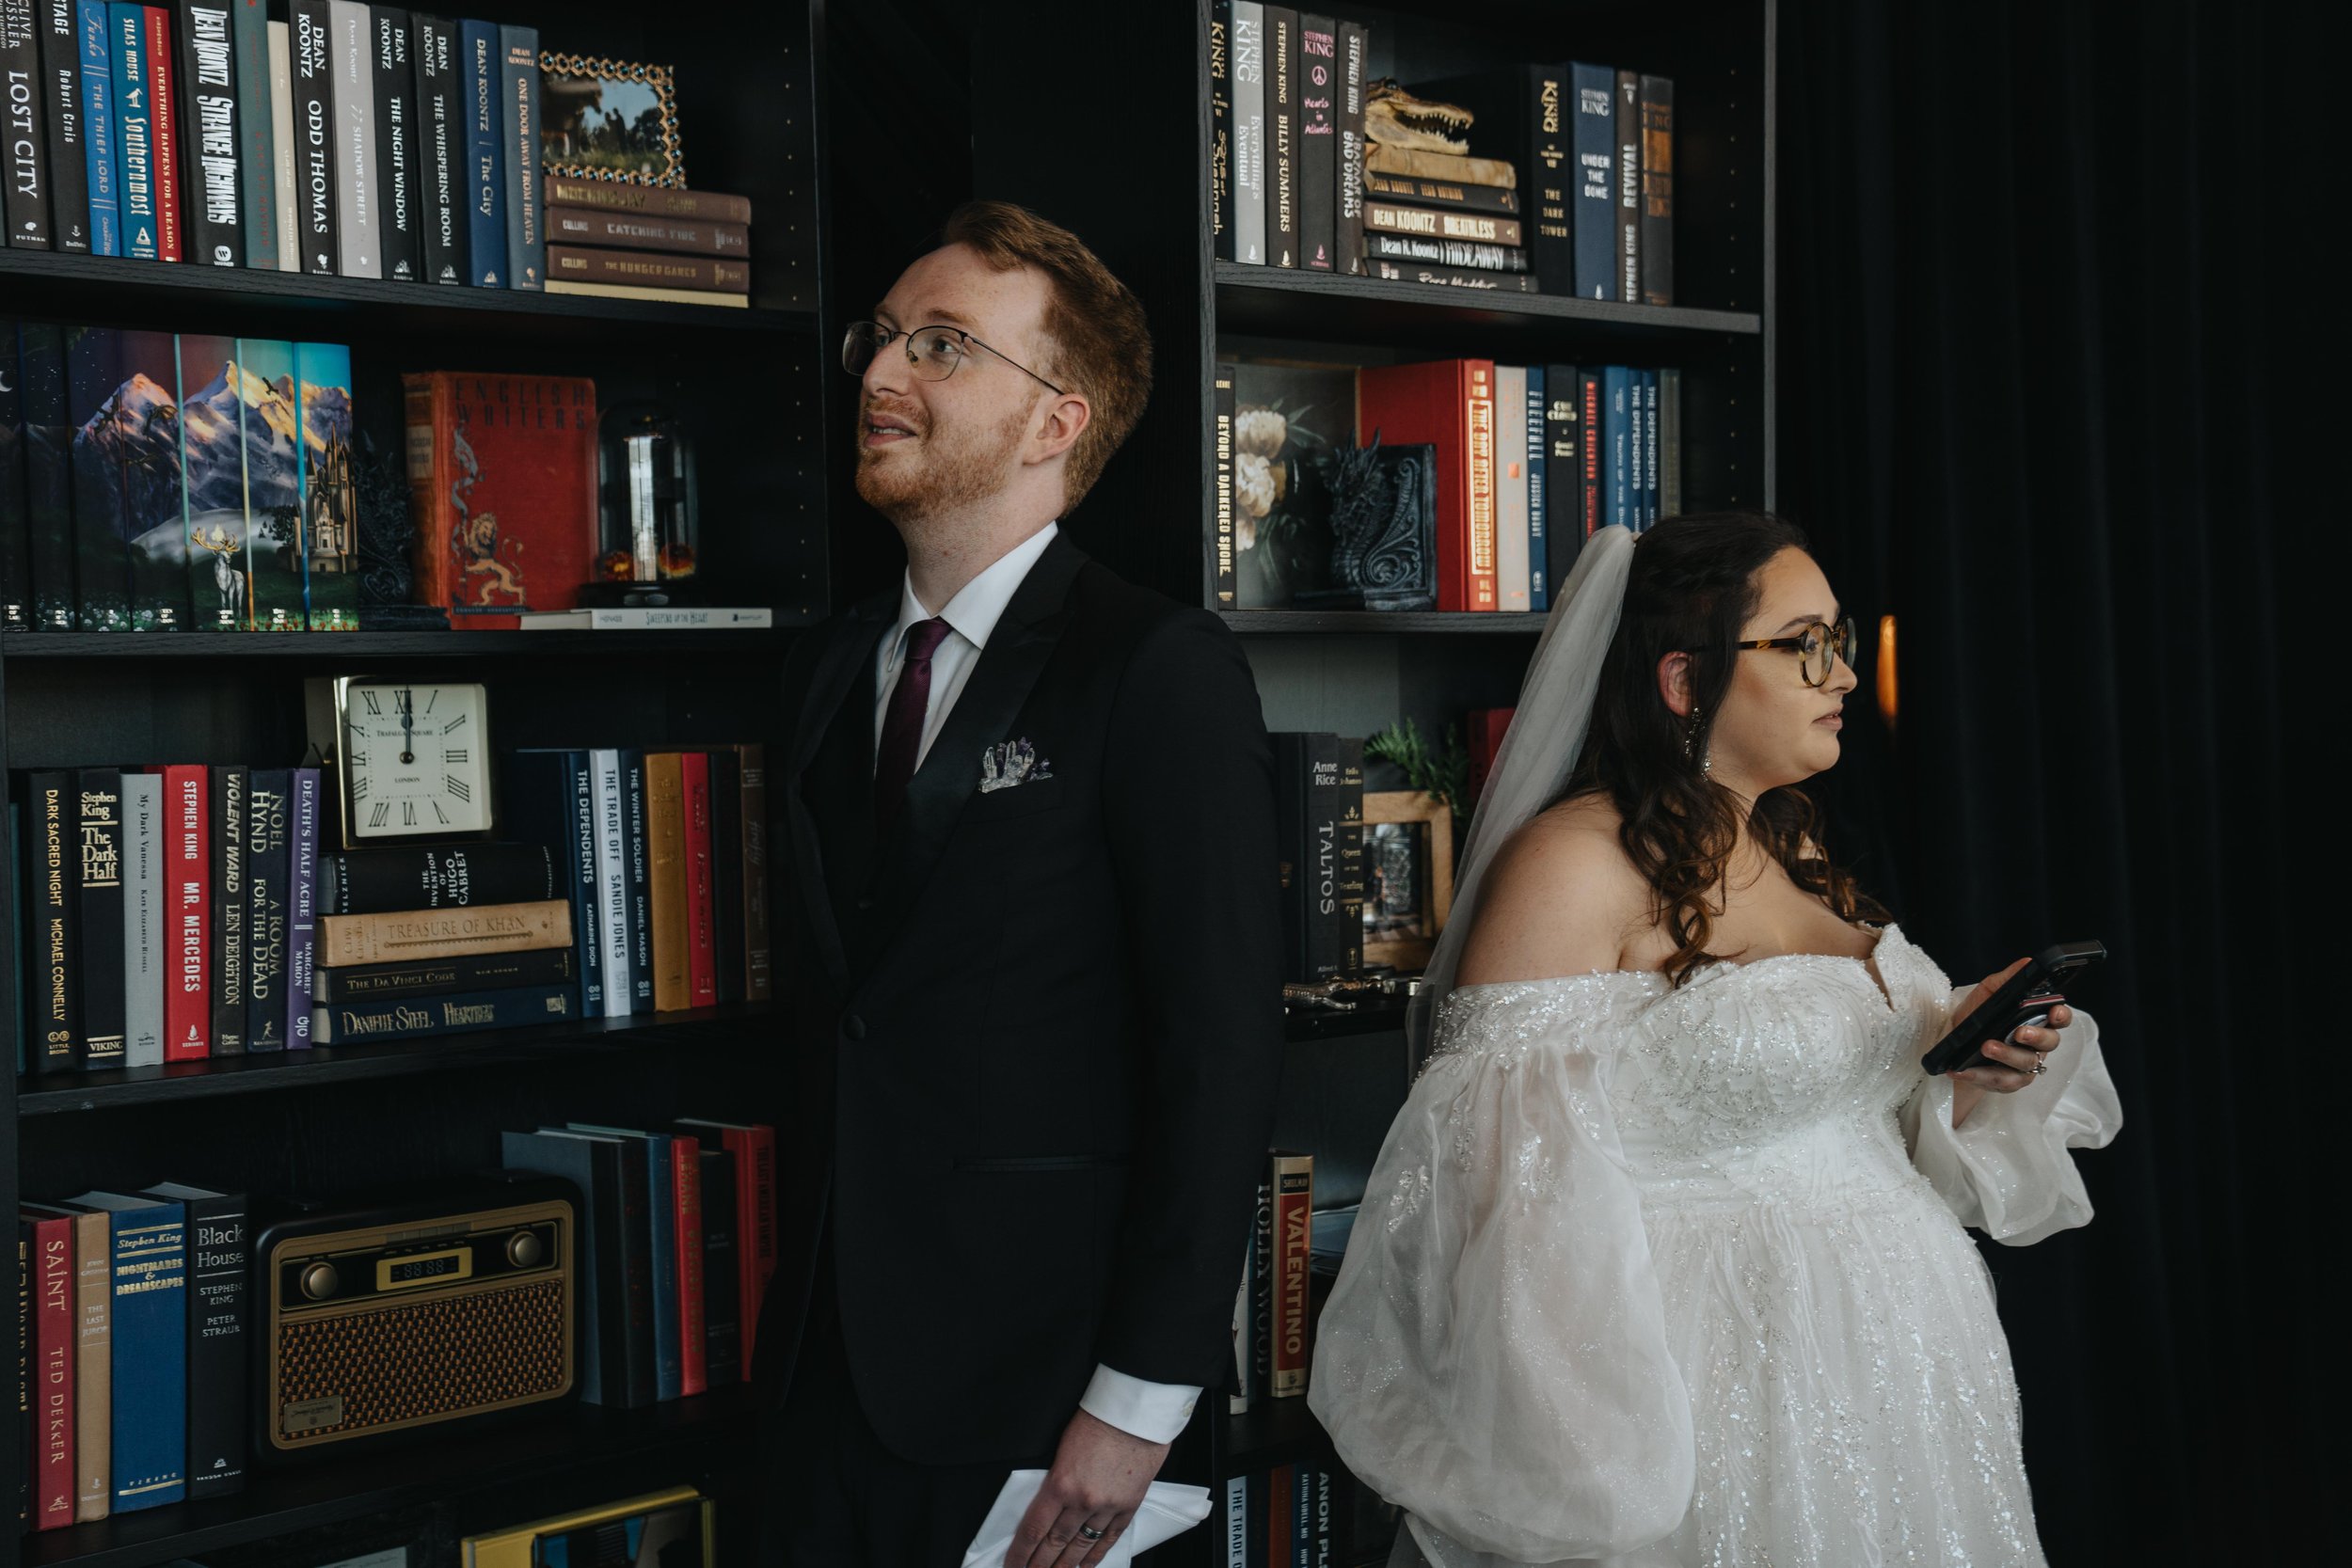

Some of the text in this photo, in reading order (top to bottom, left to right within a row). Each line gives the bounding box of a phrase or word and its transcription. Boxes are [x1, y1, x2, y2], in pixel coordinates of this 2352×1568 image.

[6, 0, 20, 48] USSLER
[18, 0, 31, 40] CLIVE
[298, 13, 312, 78] KOONTZ
[380, 18, 391, 70] KOONTZ
[395, 28, 405, 62] DEAN
[1304, 30, 1333, 43] STEPHEN
[123, 18, 139, 81] SILAS HOUSE
[190, 7, 230, 87] DEAN KOONTZ
[312, 25, 325, 70] DEAN
[423, 25, 436, 77] KOONTZ
[437, 36, 448, 71] DEAN
[1236, 19, 1252, 82] KING
[1251, 21, 1261, 85] STEPHEN
[1278, 22, 1287, 103] STEPHEN KING
[1304, 40, 1333, 57] KING
[157, 66, 168, 129] EVERYTHING
[477, 39, 489, 132] DEAN KOONTZ
[1347, 35, 1361, 114] STEPHEN KING
[1304, 97, 1329, 109] Hearts
[1315, 111, 1324, 121] in
[1581, 100, 1611, 118] KING
[8, 71, 38, 198] LOST CITY
[92, 84, 109, 194] THE THIEF LORD
[161, 132, 171, 177] HAPPENS
[1238, 124, 1250, 187] Eventual
[125, 117, 151, 215] Southernmost
[308, 100, 328, 233] ODD THOMAS
[390, 97, 406, 231] THE NIGHT WINDOW
[434, 94, 451, 247] THE WHISPERING ROOM
[480, 155, 494, 216] The City
[518, 77, 534, 245] ONE DOOR AWAY FROM HEAVEN
[1278, 115, 1291, 232] BILLY SUMMERS
[1343, 131, 1356, 219] BAD DREAMS
[1581, 153, 1611, 168] UNDER
[1587, 169, 1605, 183] THE
[1623, 144, 1638, 208] REVIVAL
[164, 179, 172, 198] FOR
[1543, 207, 1564, 219] DARK
[1545, 189, 1561, 201] THE
[1584, 184, 1609, 199] DOME
[165, 212, 175, 249] REASON
[1374, 209, 1436, 233] DEAN KOONTZ
[605, 261, 697, 278] THE HUNGER GAMES
[1445, 242, 1505, 270] HIDEAWAY
[455, 379, 586, 406] ENGLISH
[455, 404, 586, 430] WRITERS
[1585, 381, 1597, 425] MICHAEL
[1585, 429, 1597, 480] CRICHTON
[1217, 416, 1231, 577] BEYOND A DARKENED SHORE
[1473, 408, 1492, 567] THE DAY AFTER TOMORROW
[1312, 761, 1338, 773] Anne
[1315, 773, 1336, 785] Rice
[81, 791, 118, 806] Stephen
[81, 803, 110, 819] King
[183, 781, 198, 860] STEPHEN KING
[251, 791, 270, 854] HYND
[269, 794, 285, 850] NOEL
[605, 769, 619, 862] THE TRADE OFF
[45, 789, 62, 907] DARK SACRED NIGHT
[82, 828, 111, 846] The
[226, 773, 240, 894] VIOLENT WARD
[299, 780, 313, 917] DEATH'S HALF ACRE
[578, 769, 593, 883] THE DEPENDENTS
[630, 768, 643, 883] THE WINTER SOLDIER
[82, 846, 118, 862] Dark
[83, 863, 118, 880] Half
[445, 858, 457, 898] HUGO
[454, 850, 469, 906] CABRET
[1319, 820, 1334, 915] TALTOS
[1342, 848, 1361, 858] Queen
[339, 857, 348, 913] SELZNICK
[427, 852, 437, 907] INVENTION
[439, 873, 446, 886] OF
[183, 882, 200, 992] MR. MERCEDES
[388, 916, 526, 940] TREASURE OF KHAN
[611, 875, 625, 958] SANDIE JONES
[636, 896, 644, 930] DANIEL
[226, 904, 240, 1005] LEN DEIGHTON
[252, 879, 269, 1000] FOR THE DEAD
[51, 918, 65, 1022] MICHAEL CONNELLY
[294, 950, 303, 987] MARON
[89, 1040, 123, 1052] VIKING
[342, 1006, 434, 1036] DANIELLE STEEL
[197, 1225, 244, 1246] Black
[197, 1251, 245, 1269] House
[46, 1240, 65, 1311] SAINT
[117, 1258, 183, 1276] NIGHTMARES
[117, 1276, 184, 1296] DREAMSCAPES
[199, 1283, 243, 1296] STEPHEN
[1285, 1206, 1305, 1355] VALENTINO
[87, 1316, 105, 1325] LAST
[207, 1315, 235, 1326] PETER
[209, 1295, 234, 1307] KING
[202, 1325, 241, 1338] STRAUB
[49, 1346, 64, 1465] TED DEKKER
[1232, 1488, 1243, 1558] THE TRADE
[1318, 1472, 1329, 1532] ANON
